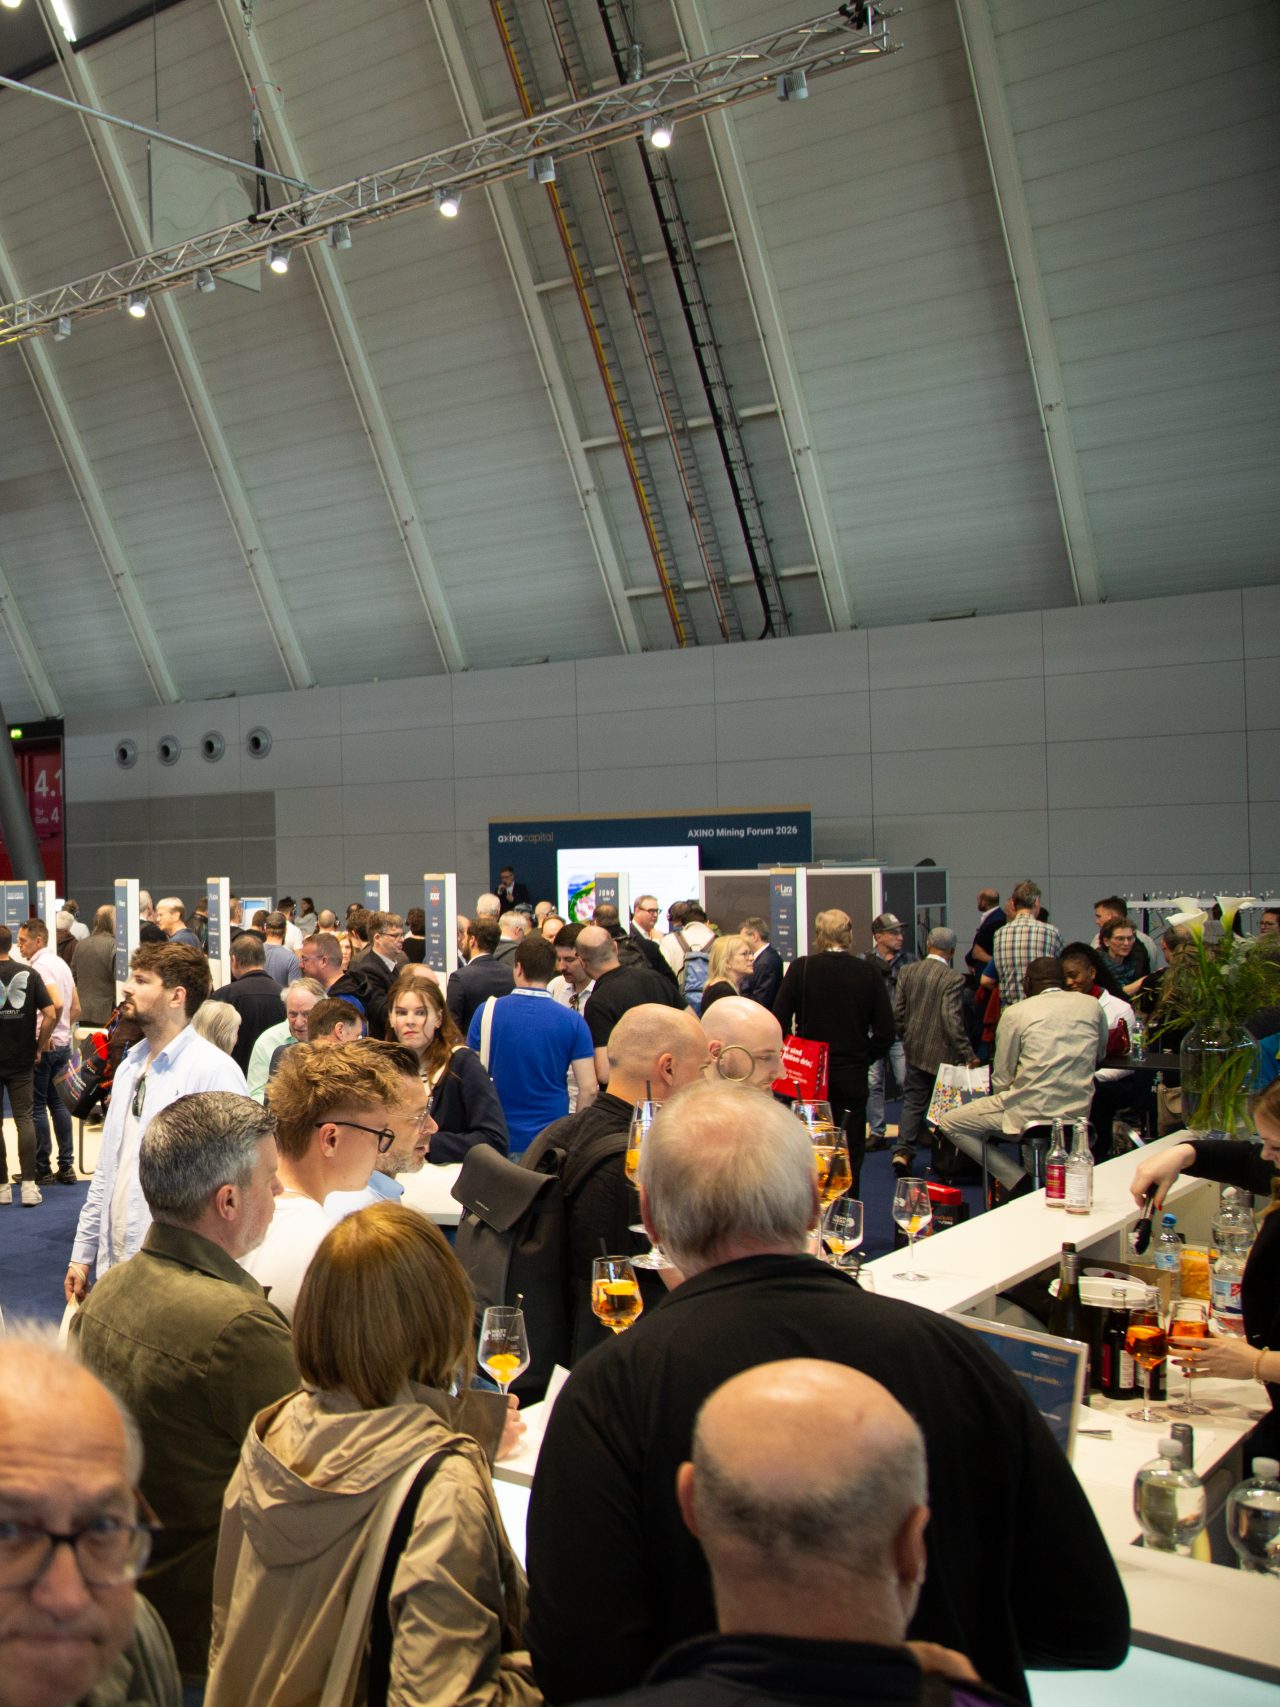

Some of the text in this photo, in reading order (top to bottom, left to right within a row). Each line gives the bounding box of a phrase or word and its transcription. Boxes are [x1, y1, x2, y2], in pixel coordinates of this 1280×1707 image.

[35, 768, 62, 797] 4.1
[51, 806, 60, 823] 4
[498, 831, 554, 843] axinocapital
[688, 825, 798, 838] AXINO Mining Forum 2026
[598, 888, 615, 897] JUNO
[780, 883, 793, 893] Lara
